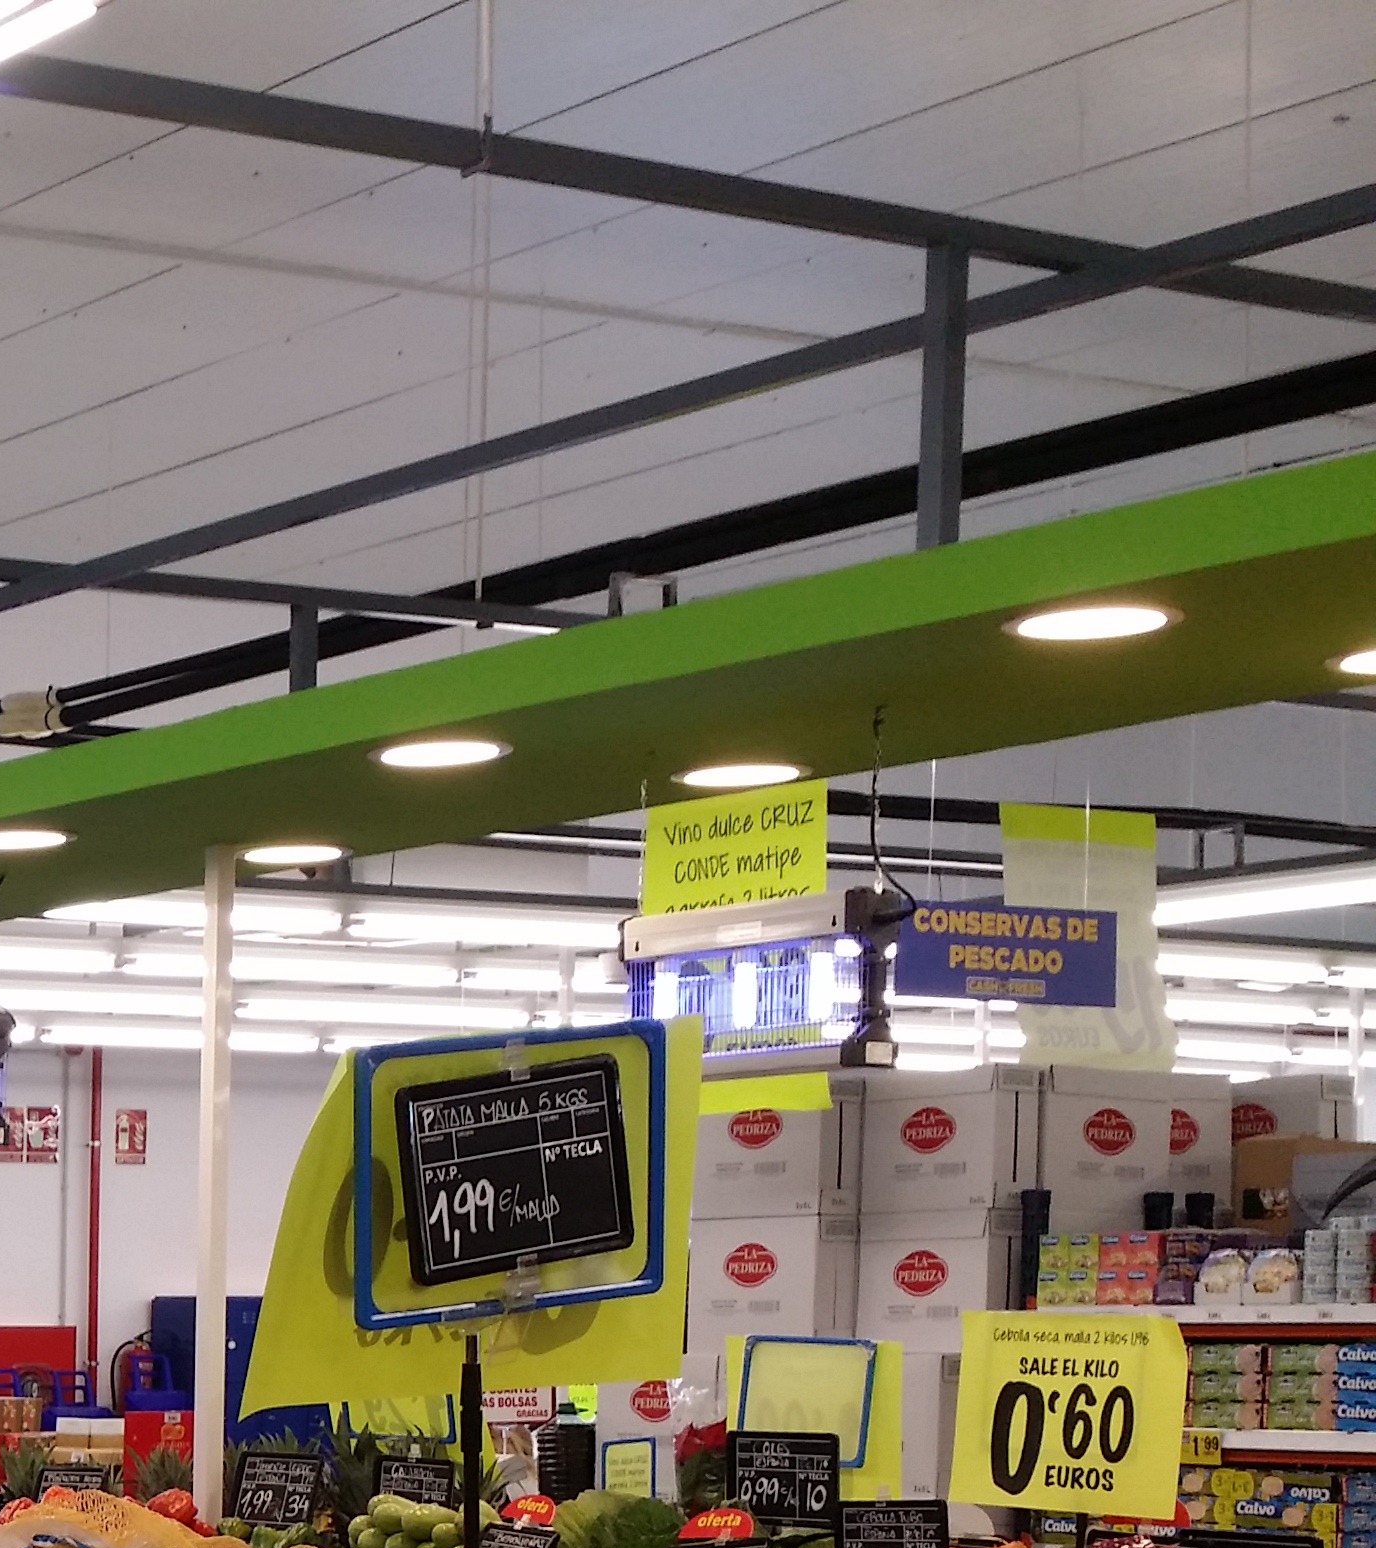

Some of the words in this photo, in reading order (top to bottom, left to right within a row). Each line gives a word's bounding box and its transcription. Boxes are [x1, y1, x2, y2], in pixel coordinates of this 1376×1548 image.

[664, 822, 701, 846] Vino
[708, 813, 754, 839] dulce
[761, 800, 814, 831] CRUZ
[675, 853, 729, 884] CONDE
[737, 845, 802, 880] matipe
[914, 907, 1062, 941] CONSERVAS
[1066, 918, 1098, 942] DE
[949, 945, 1064, 975] PESCADO
[422, 1105, 475, 1134] PATATA
[480, 1097, 529, 1124] MALLA
[539, 1091, 552, 1113] 5
[555, 1088, 589, 1108] KGS
[921, 1112, 936, 1125] LA
[1103, 1113, 1117, 1126] LA
[733, 1123, 780, 1136] PEDRIZA
[905, 1126, 954, 1140] PEDRIZA
[1088, 1127, 1131, 1142] PEDRIZA
[545, 1146, 561, 1163] Nº
[563, 1139, 603, 1160] TECLA
[425, 1166, 462, 1184] P.V.P.
[429, 1178, 495, 1259] 1,99
[744, 1247, 757, 1259] LA
[728, 1261, 775, 1275] PEDRIZA
[915, 1255, 928, 1268] LA
[898, 1269, 944, 1282] PEDRIZA
[993, 1328, 1030, 1342] Cebolla
[1064, 1332, 1091, 1344] malla
[1093, 1331, 1100, 1344] 2
[1104, 1332, 1128, 1345] kilos
[1338, 1346, 1376, 1362] Calvo
[1019, 1357, 1058, 1375] SALE
[1062, 1359, 1079, 1377] EL
[1084, 1359, 1119, 1378] KILO
[648, 1384, 663, 1396] LA
[1338, 1376, 1376, 1390] Calvo
[498, 1397, 537, 1407] BOLSAS
[634, 1397, 669, 1409] PEDRIZ
[1337, 1404, 1376, 1419] Calvo
[808, 1473, 829, 1481] TECLA
[1045, 1465, 1114, 1492] EUROS
[741, 1477, 779, 1506] 0,99
[807, 1483, 827, 1512] 10
[1290, 1486, 1330, 1501] Calvo
[241, 1490, 273, 1518] 1,99
[285, 1494, 309, 1519] 34
[517, 1498, 549, 1513] oferta
[1236, 1501, 1276, 1516] Calvo
[698, 1513, 741, 1527] oferta
